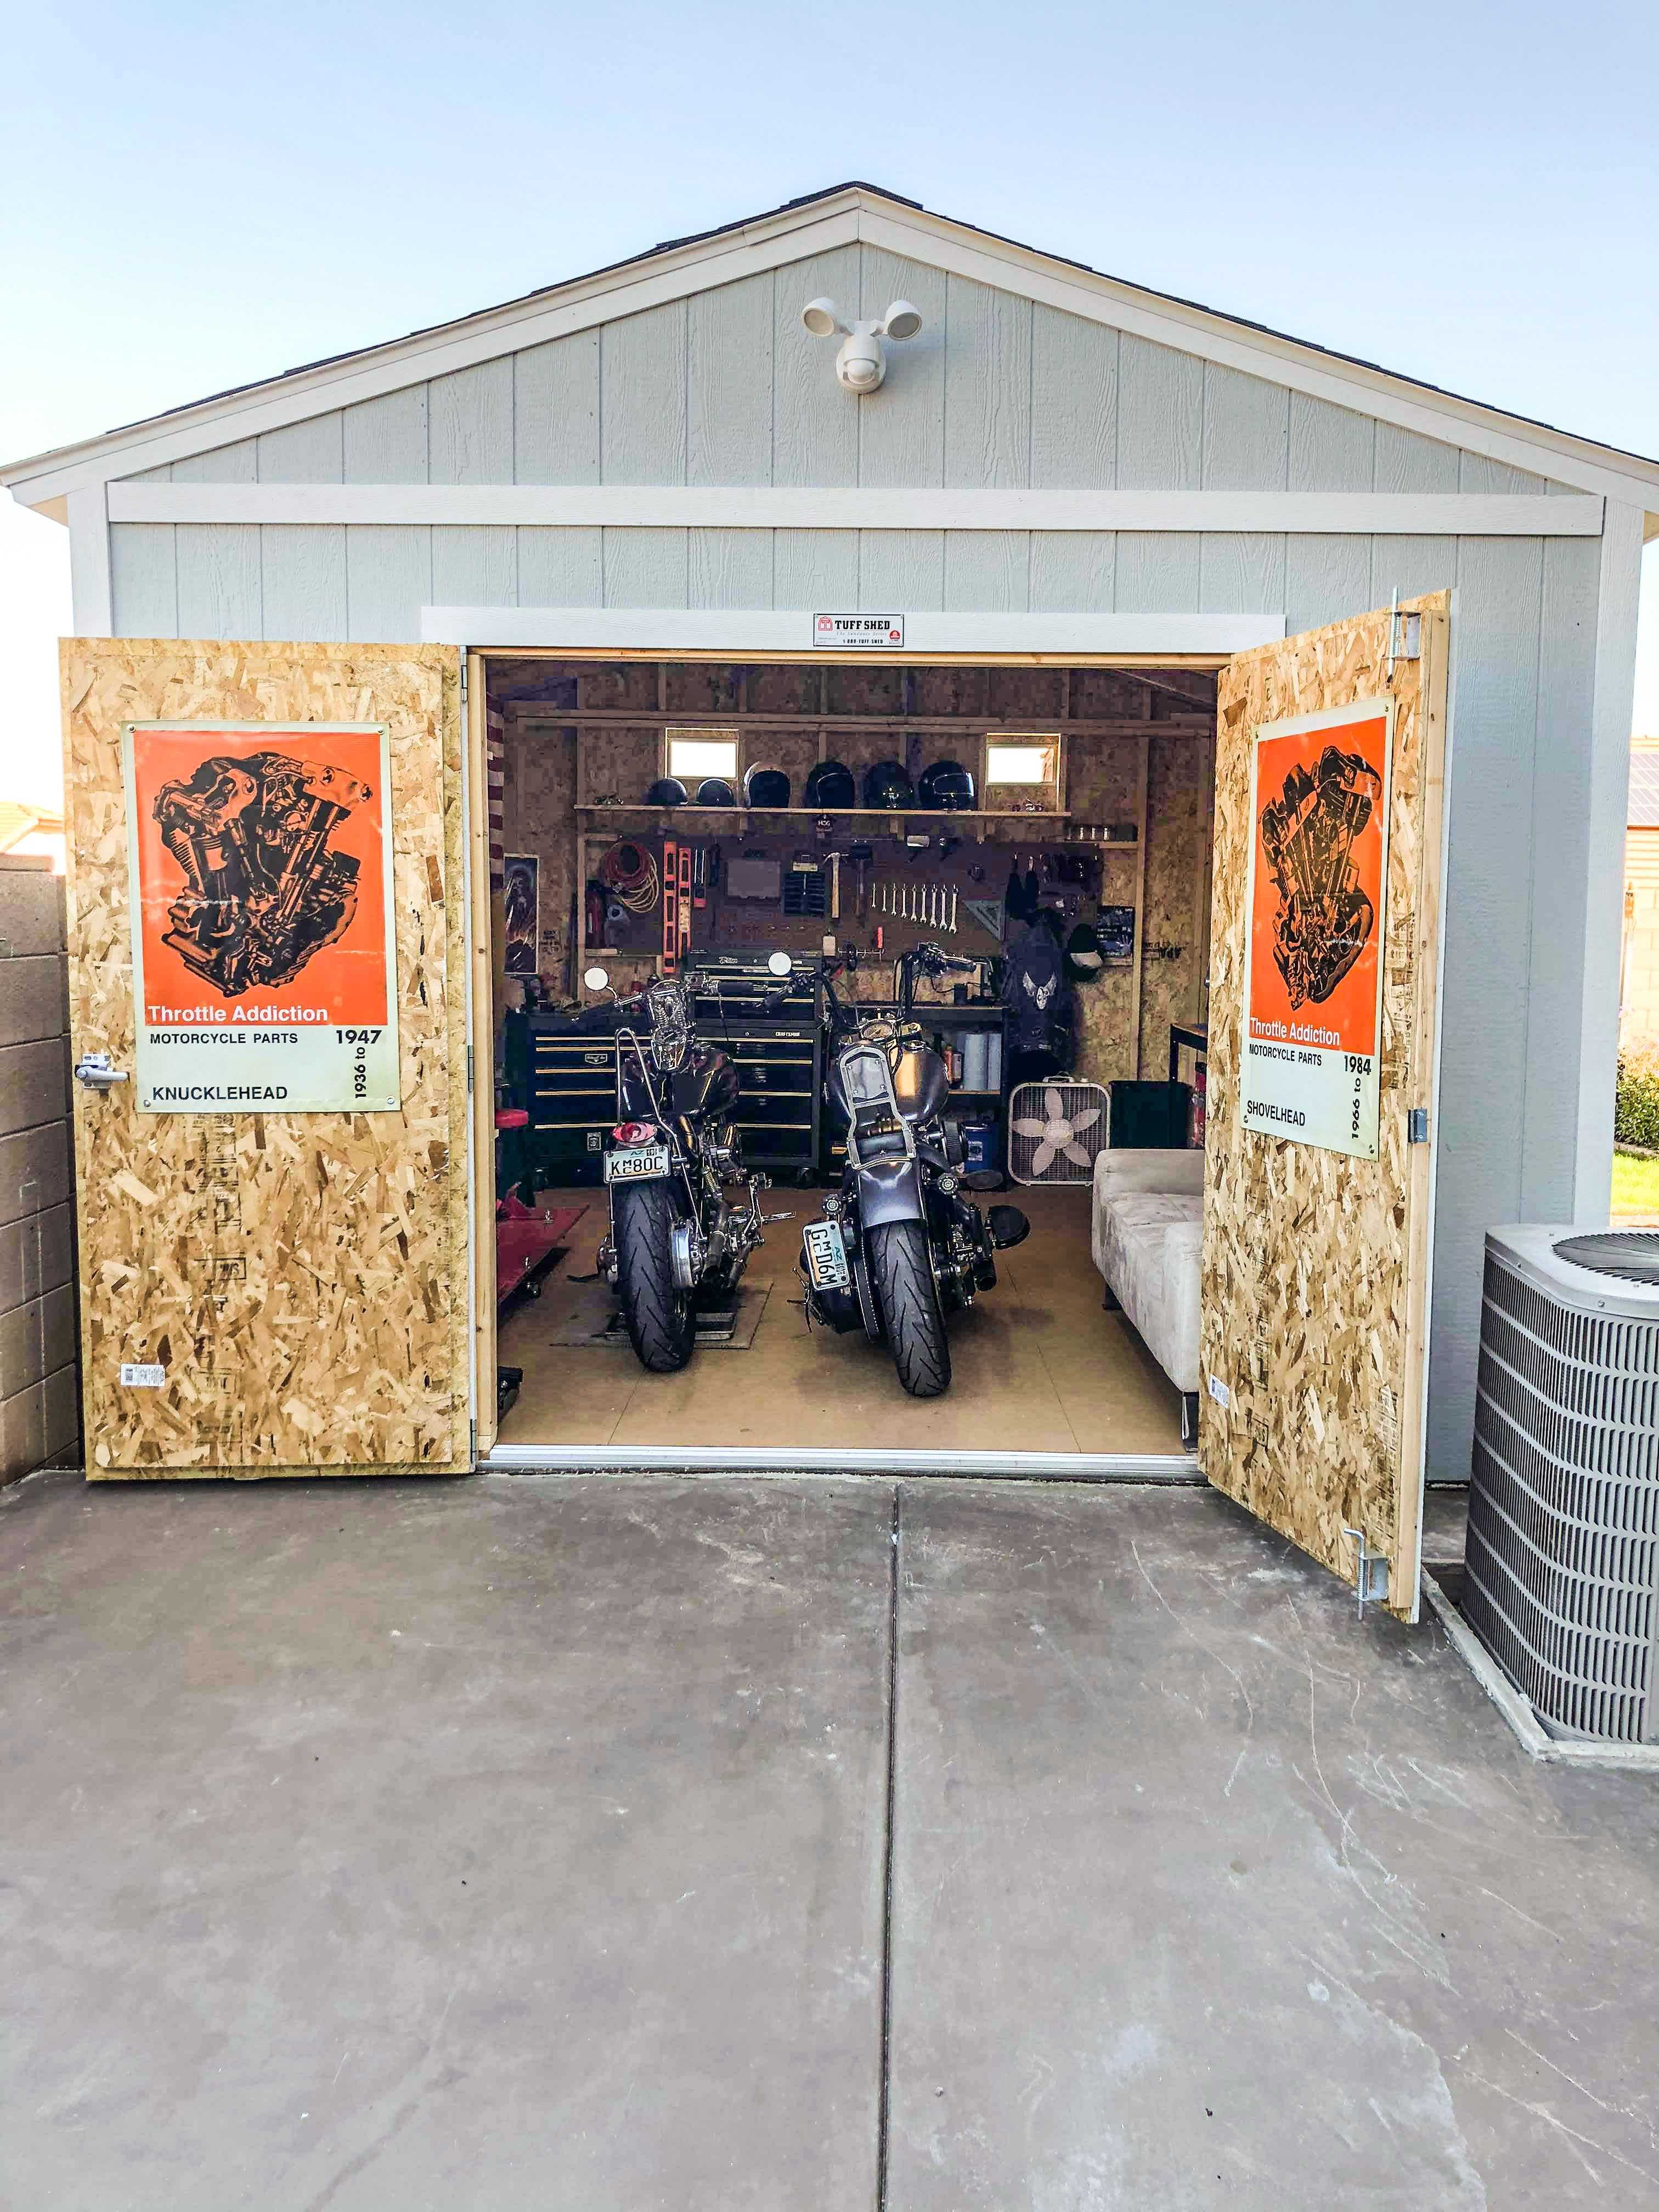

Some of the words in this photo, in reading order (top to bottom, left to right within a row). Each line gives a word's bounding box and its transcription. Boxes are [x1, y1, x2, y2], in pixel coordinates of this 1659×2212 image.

[834, 620, 862, 630] TUFF
[864, 620, 890, 630] SHED
[148, 1005, 227, 1022] Throttle
[232, 1005, 328, 1022] Addiction
[150, 1033, 246, 1044] MOTORCYCLE
[253, 1033, 298, 1043] PARTS
[336, 1030, 382, 1045] 1947
[1250, 1018, 1287, 1039] Throttle
[1290, 1022, 1340, 1045] Addiction
[354, 1047, 365, 1059] to
[1249, 1044, 1295, 1062] MOTORCYCLE
[1298, 1052, 1322, 1066] PARTS
[1344, 1055, 1372, 1075] 1984
[354, 1064, 366, 1098] 1936
[1354, 1077, 1361, 1093] to
[153, 1086, 287, 1100] KNUCKLEHEAD
[1247, 1100, 1306, 1126] SHOVELHEAD
[1352, 1098, 1360, 1139] 1966
[834, 1246, 842, 1261] AZ
